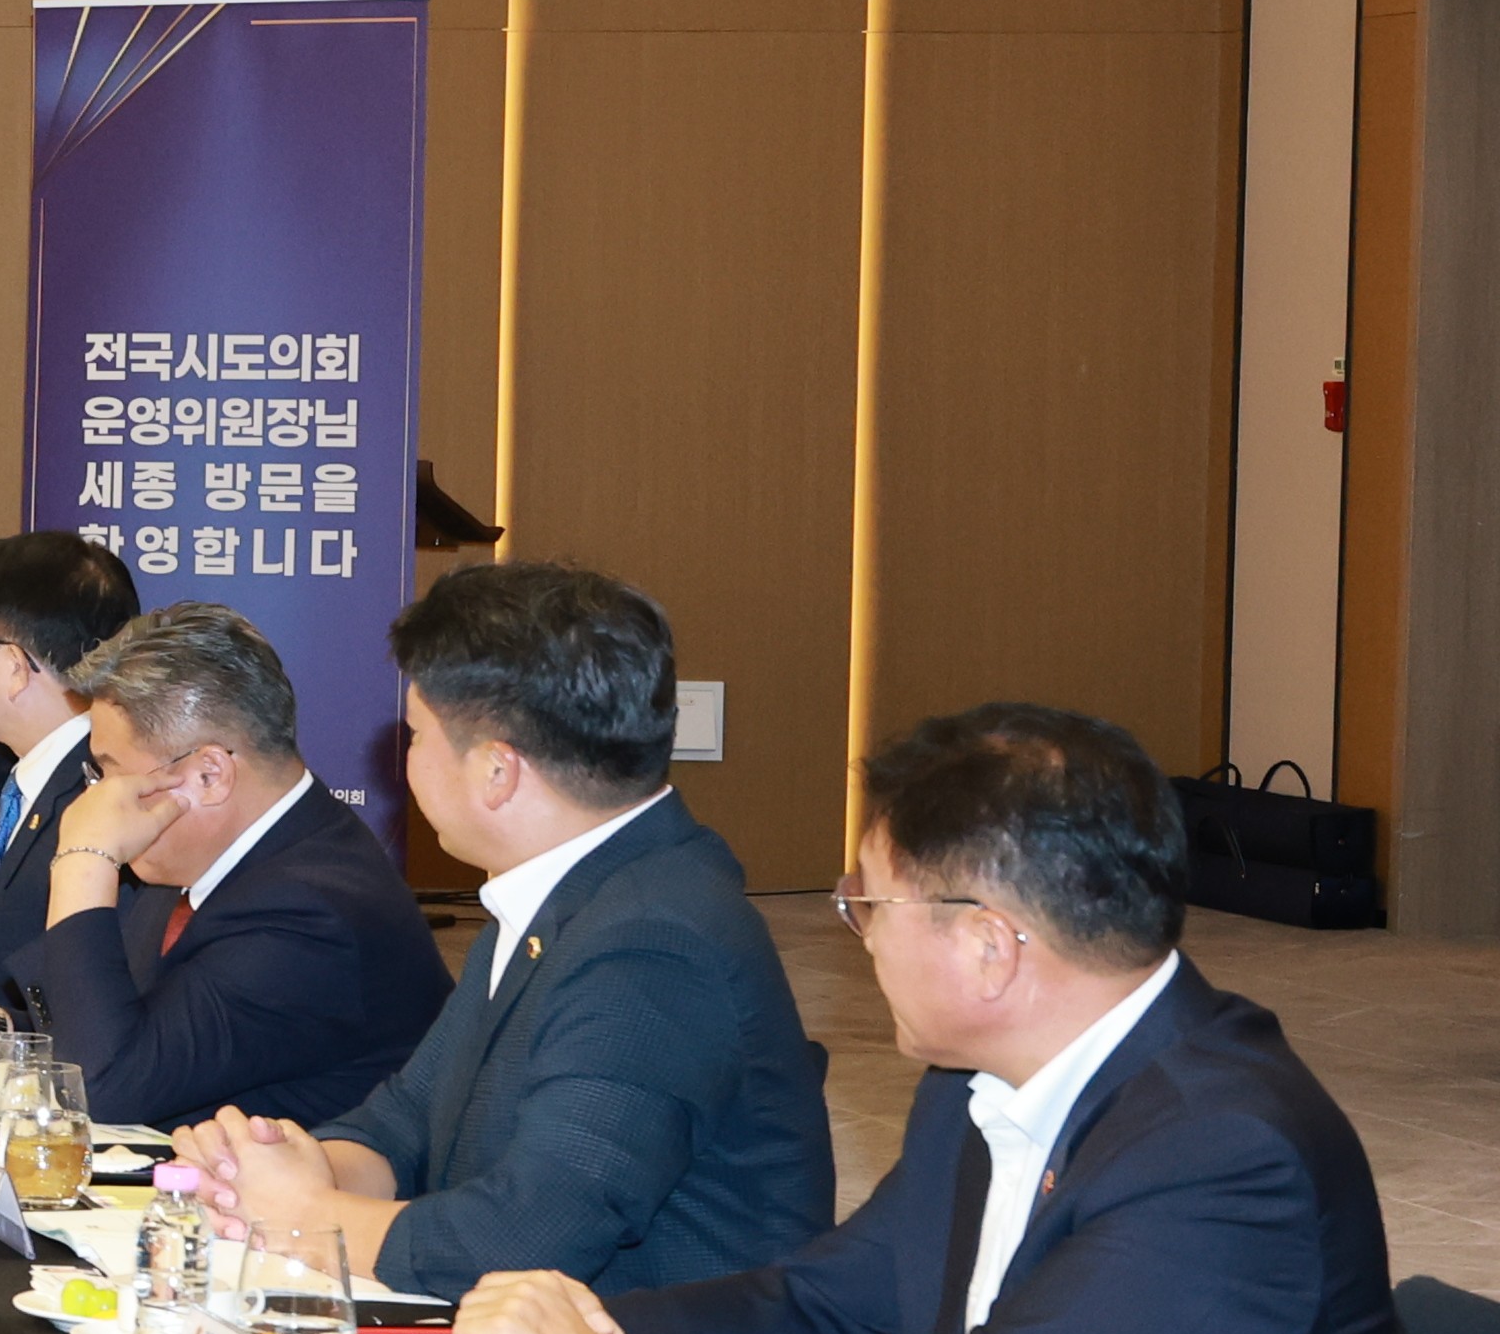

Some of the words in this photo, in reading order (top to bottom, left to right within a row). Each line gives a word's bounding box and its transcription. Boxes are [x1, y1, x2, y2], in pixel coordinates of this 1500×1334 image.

[84, 332, 360, 383] 전국시도의회
[81, 396, 358, 448] 운영위원장님
[78, 461, 177, 510] 세종
[205, 462, 358, 513] 방문을
